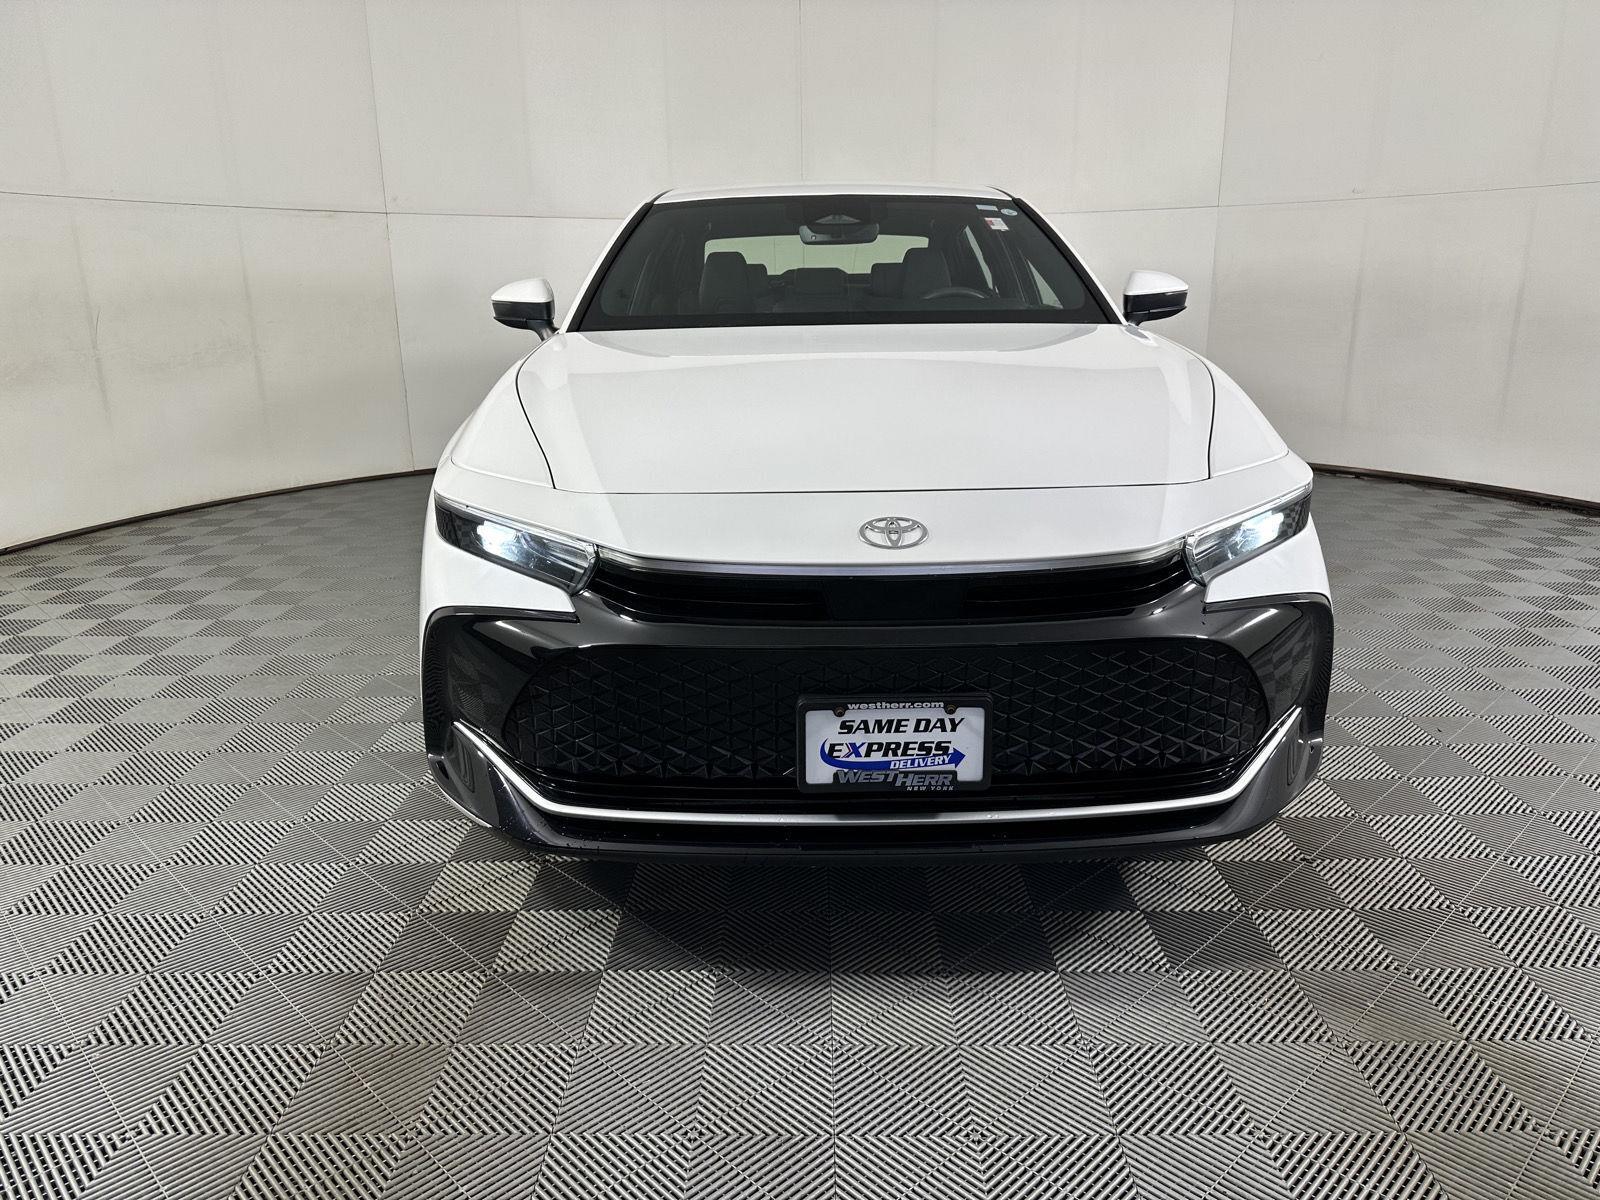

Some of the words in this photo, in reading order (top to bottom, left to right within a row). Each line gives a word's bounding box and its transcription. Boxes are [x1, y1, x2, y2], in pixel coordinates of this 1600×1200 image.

[847, 701, 945, 710] westherr.com
[837, 717, 910, 735] SAME
[913, 717, 965, 734] DAY
[828, 741, 952, 758] EXPRESS
[890, 755, 951, 769] DELIVERY
